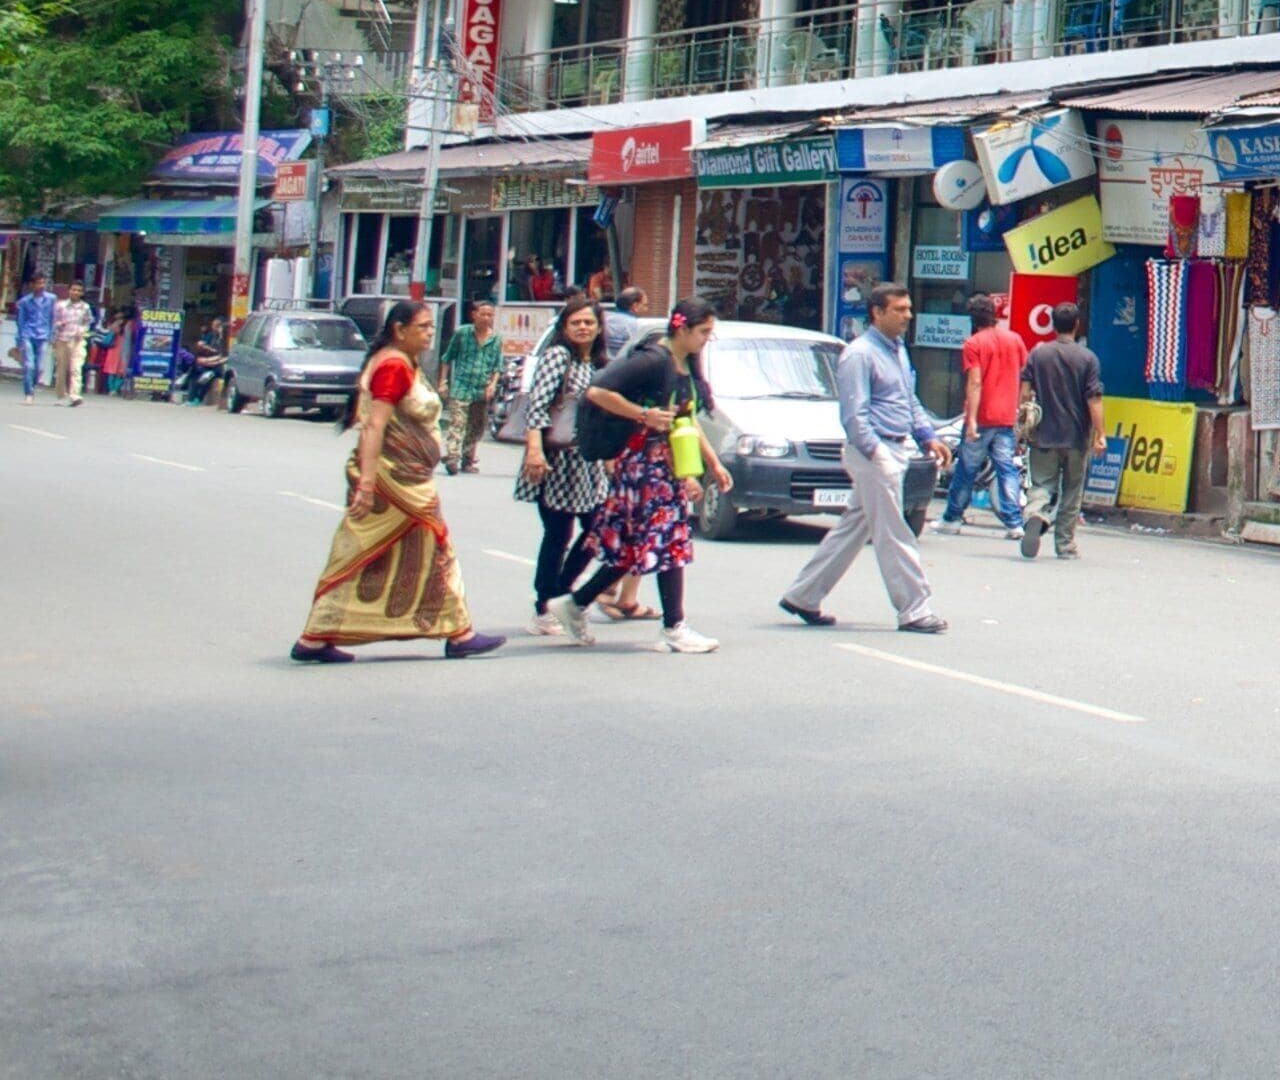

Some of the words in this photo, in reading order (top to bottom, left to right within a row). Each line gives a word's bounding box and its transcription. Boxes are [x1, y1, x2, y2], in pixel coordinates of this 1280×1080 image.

[634, 142, 660, 165] airtel
[697, 149, 752, 176] Diamond
[754, 145, 781, 173] Gift
[782, 142, 835, 172] Gallery
[916, 249, 939, 261] HOTEL
[941, 249, 968, 262] ROOMS
[921, 263, 961, 276] AVAILABLE
[142, 309, 181, 322] SURYA
